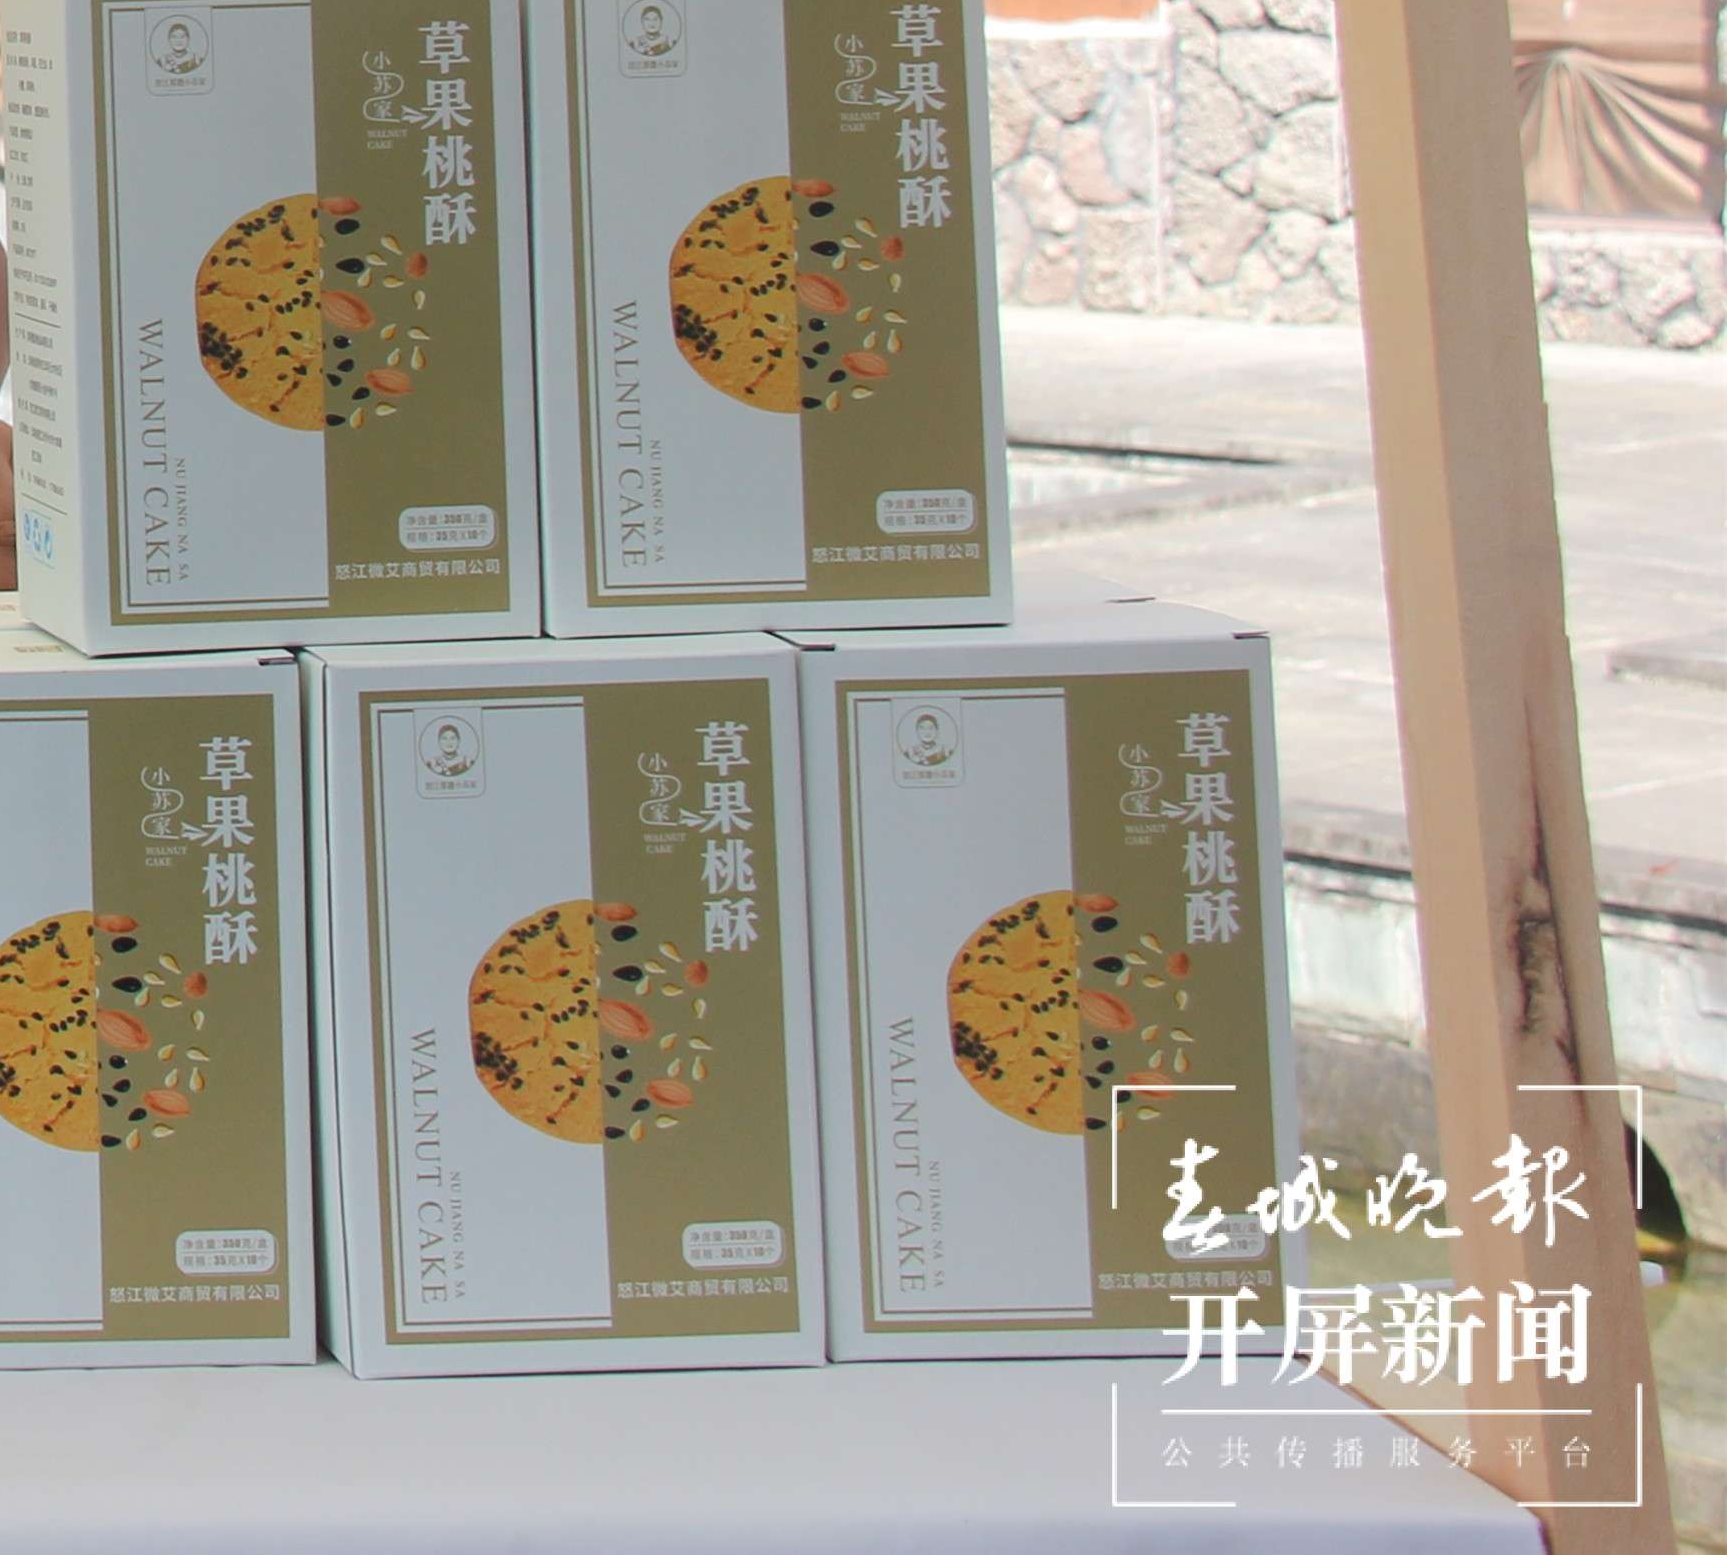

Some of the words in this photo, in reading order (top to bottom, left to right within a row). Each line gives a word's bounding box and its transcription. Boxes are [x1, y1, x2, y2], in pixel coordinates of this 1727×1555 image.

[373, 51, 392, 119] 小苏家
[845, 34, 865, 102] 小苏家
[890, 4, 952, 228] 草果桃酥
[418, 20, 477, 246] 草果桃酥
[139, 317, 167, 473] WALNUT
[612, 299, 642, 455] WALNUT
[143, 486, 171, 586] CAKE
[619, 468, 647, 568] CAKE
[812, 541, 980, 563] 怒江微艾商贸有限公司
[335, 558, 501, 580] 怒江微艾商贸有限公司
[152, 767, 171, 836] 小苏家
[649, 753, 670, 823] 小苏家
[1129, 744, 1150, 814] 小苏家
[1175, 713, 1241, 944] 草果桃酥
[198, 736, 258, 965] 草果桃酥
[694, 721, 759, 953] 草果桃酥
[411, 1026, 442, 1187] WALNUT
[889, 1016, 920, 1176] WALNUT
[417, 1200, 447, 1303] CAKE
[616, 1276, 789, 1299] 怒江微艾商贸有限公司
[896, 1190, 926, 1293] CAKE
[109, 1284, 281, 1303] 怒江微艾商贸有限公司
